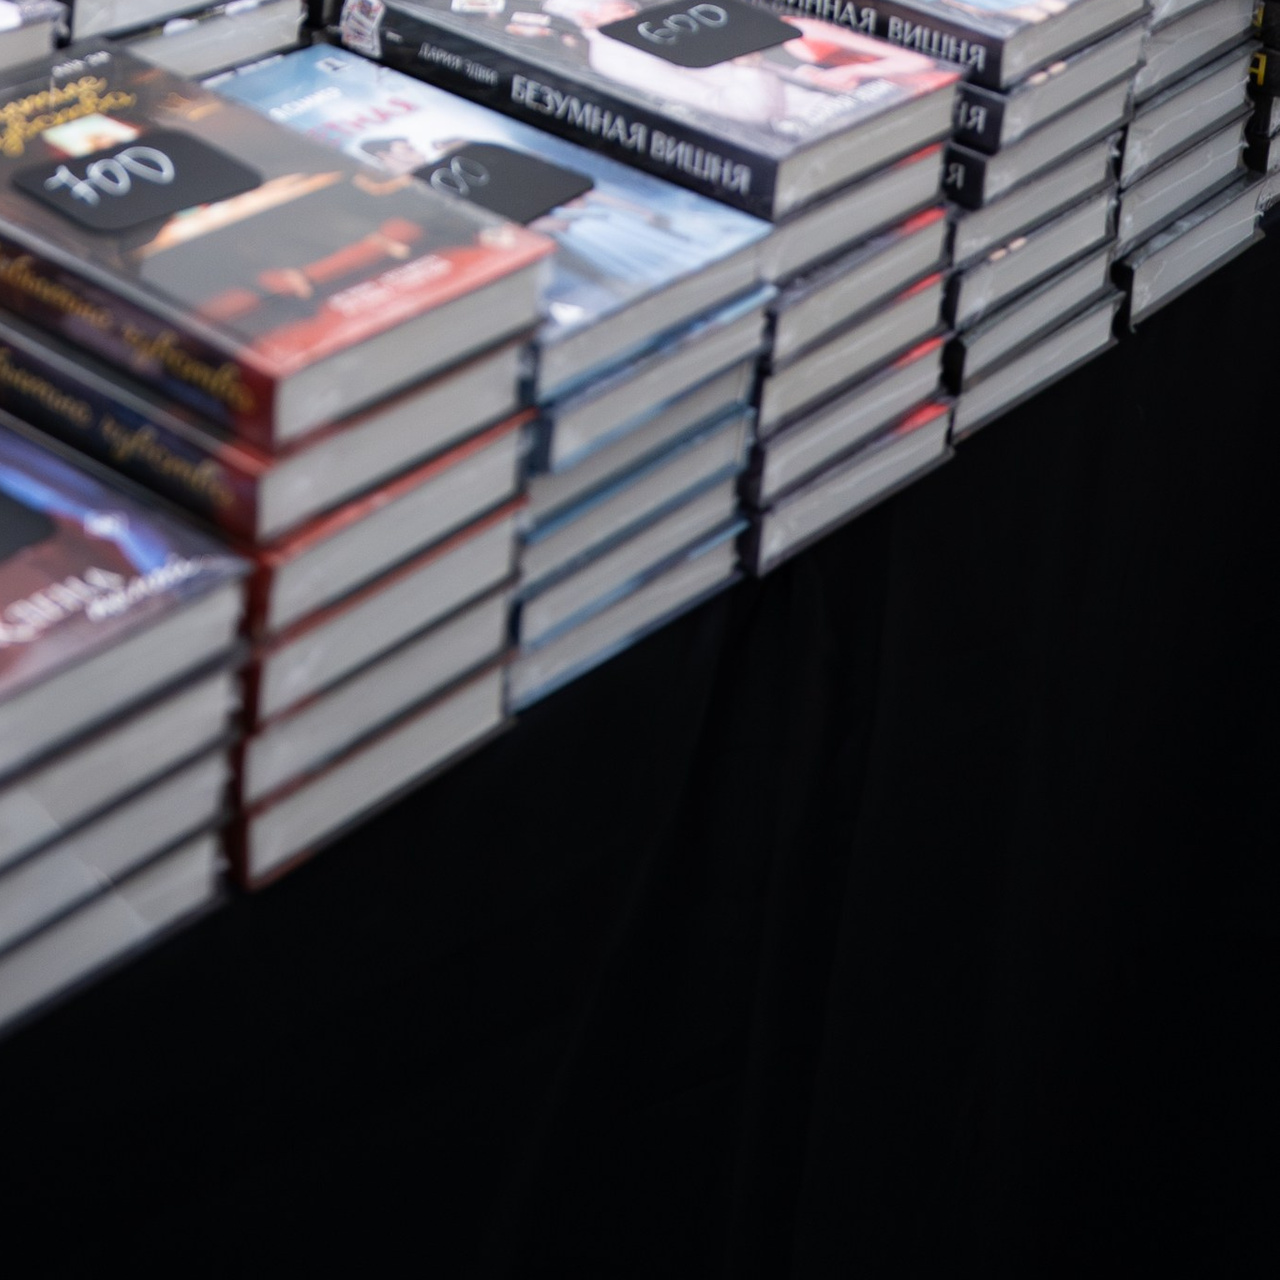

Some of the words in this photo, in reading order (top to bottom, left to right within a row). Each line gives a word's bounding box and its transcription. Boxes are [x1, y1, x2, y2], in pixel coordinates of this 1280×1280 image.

[637, 2, 729, 46] 600
[886, 14, 987, 73] ВИШНЯ
[510, 74, 650, 153] БЕЗУМНАЯ
[649, 129, 752, 196] ВИШНЯ
[44, 145, 176, 206] 700
